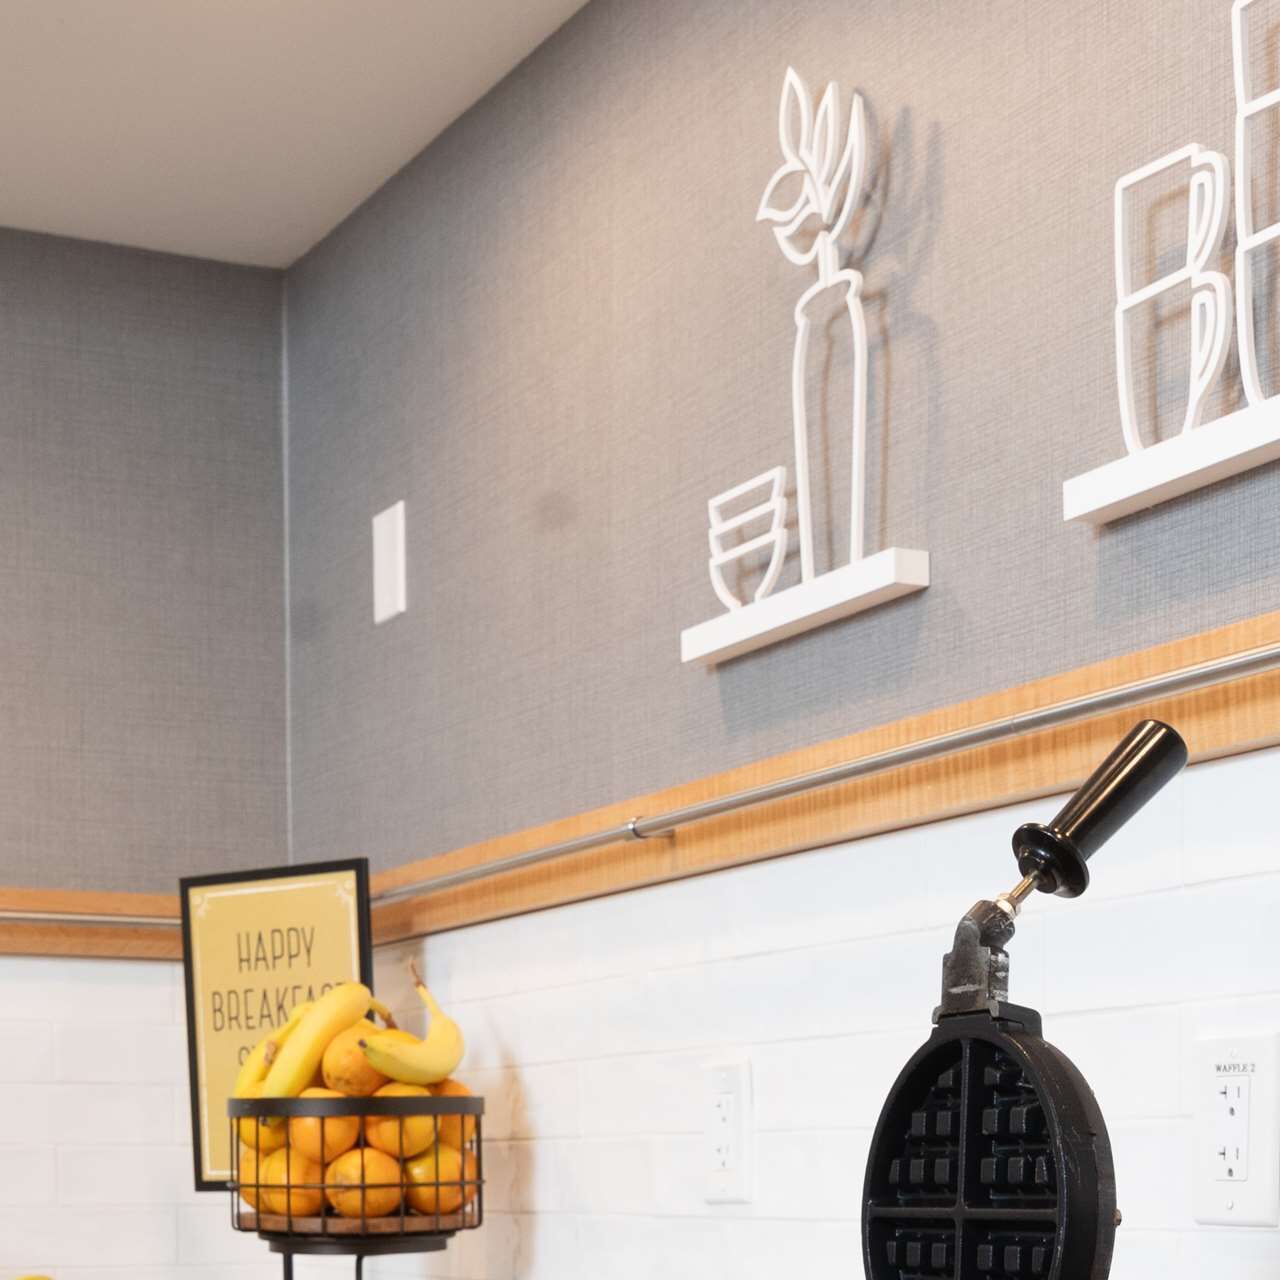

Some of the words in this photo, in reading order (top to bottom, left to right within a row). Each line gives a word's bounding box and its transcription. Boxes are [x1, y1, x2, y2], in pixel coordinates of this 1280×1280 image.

[236, 926, 315, 973] HAPPY
[211, 981, 347, 1032] BREAK
[1215, 1063, 1248, 1073] WAFFLE
